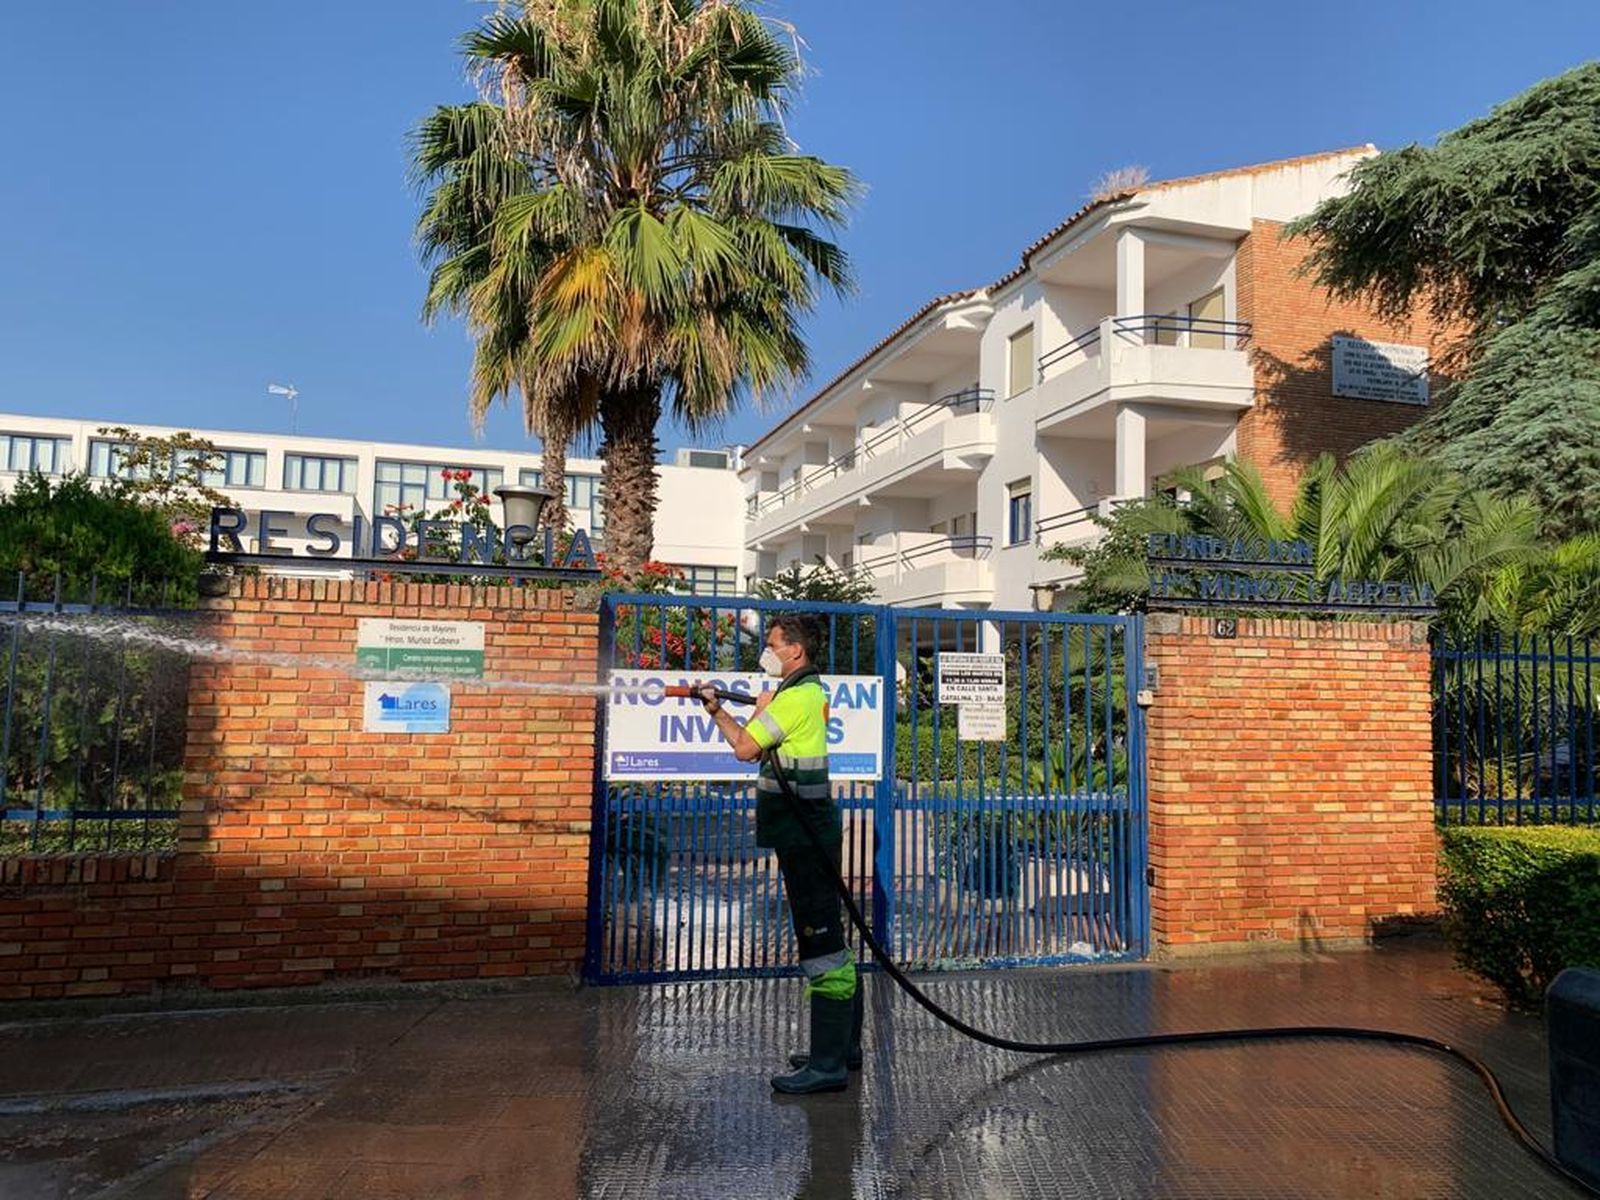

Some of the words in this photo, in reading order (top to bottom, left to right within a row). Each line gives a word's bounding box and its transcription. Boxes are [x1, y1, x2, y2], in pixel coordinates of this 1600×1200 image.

[209, 507, 598, 569] RESIDENCIA
[389, 623, 420, 632] Residencia
[432, 624, 457, 635] Mayores
[1217, 619, 1235, 637] 62
[614, 677, 665, 706] NO
[396, 697, 437, 710] Lares
[630, 755, 659, 767] Lares
